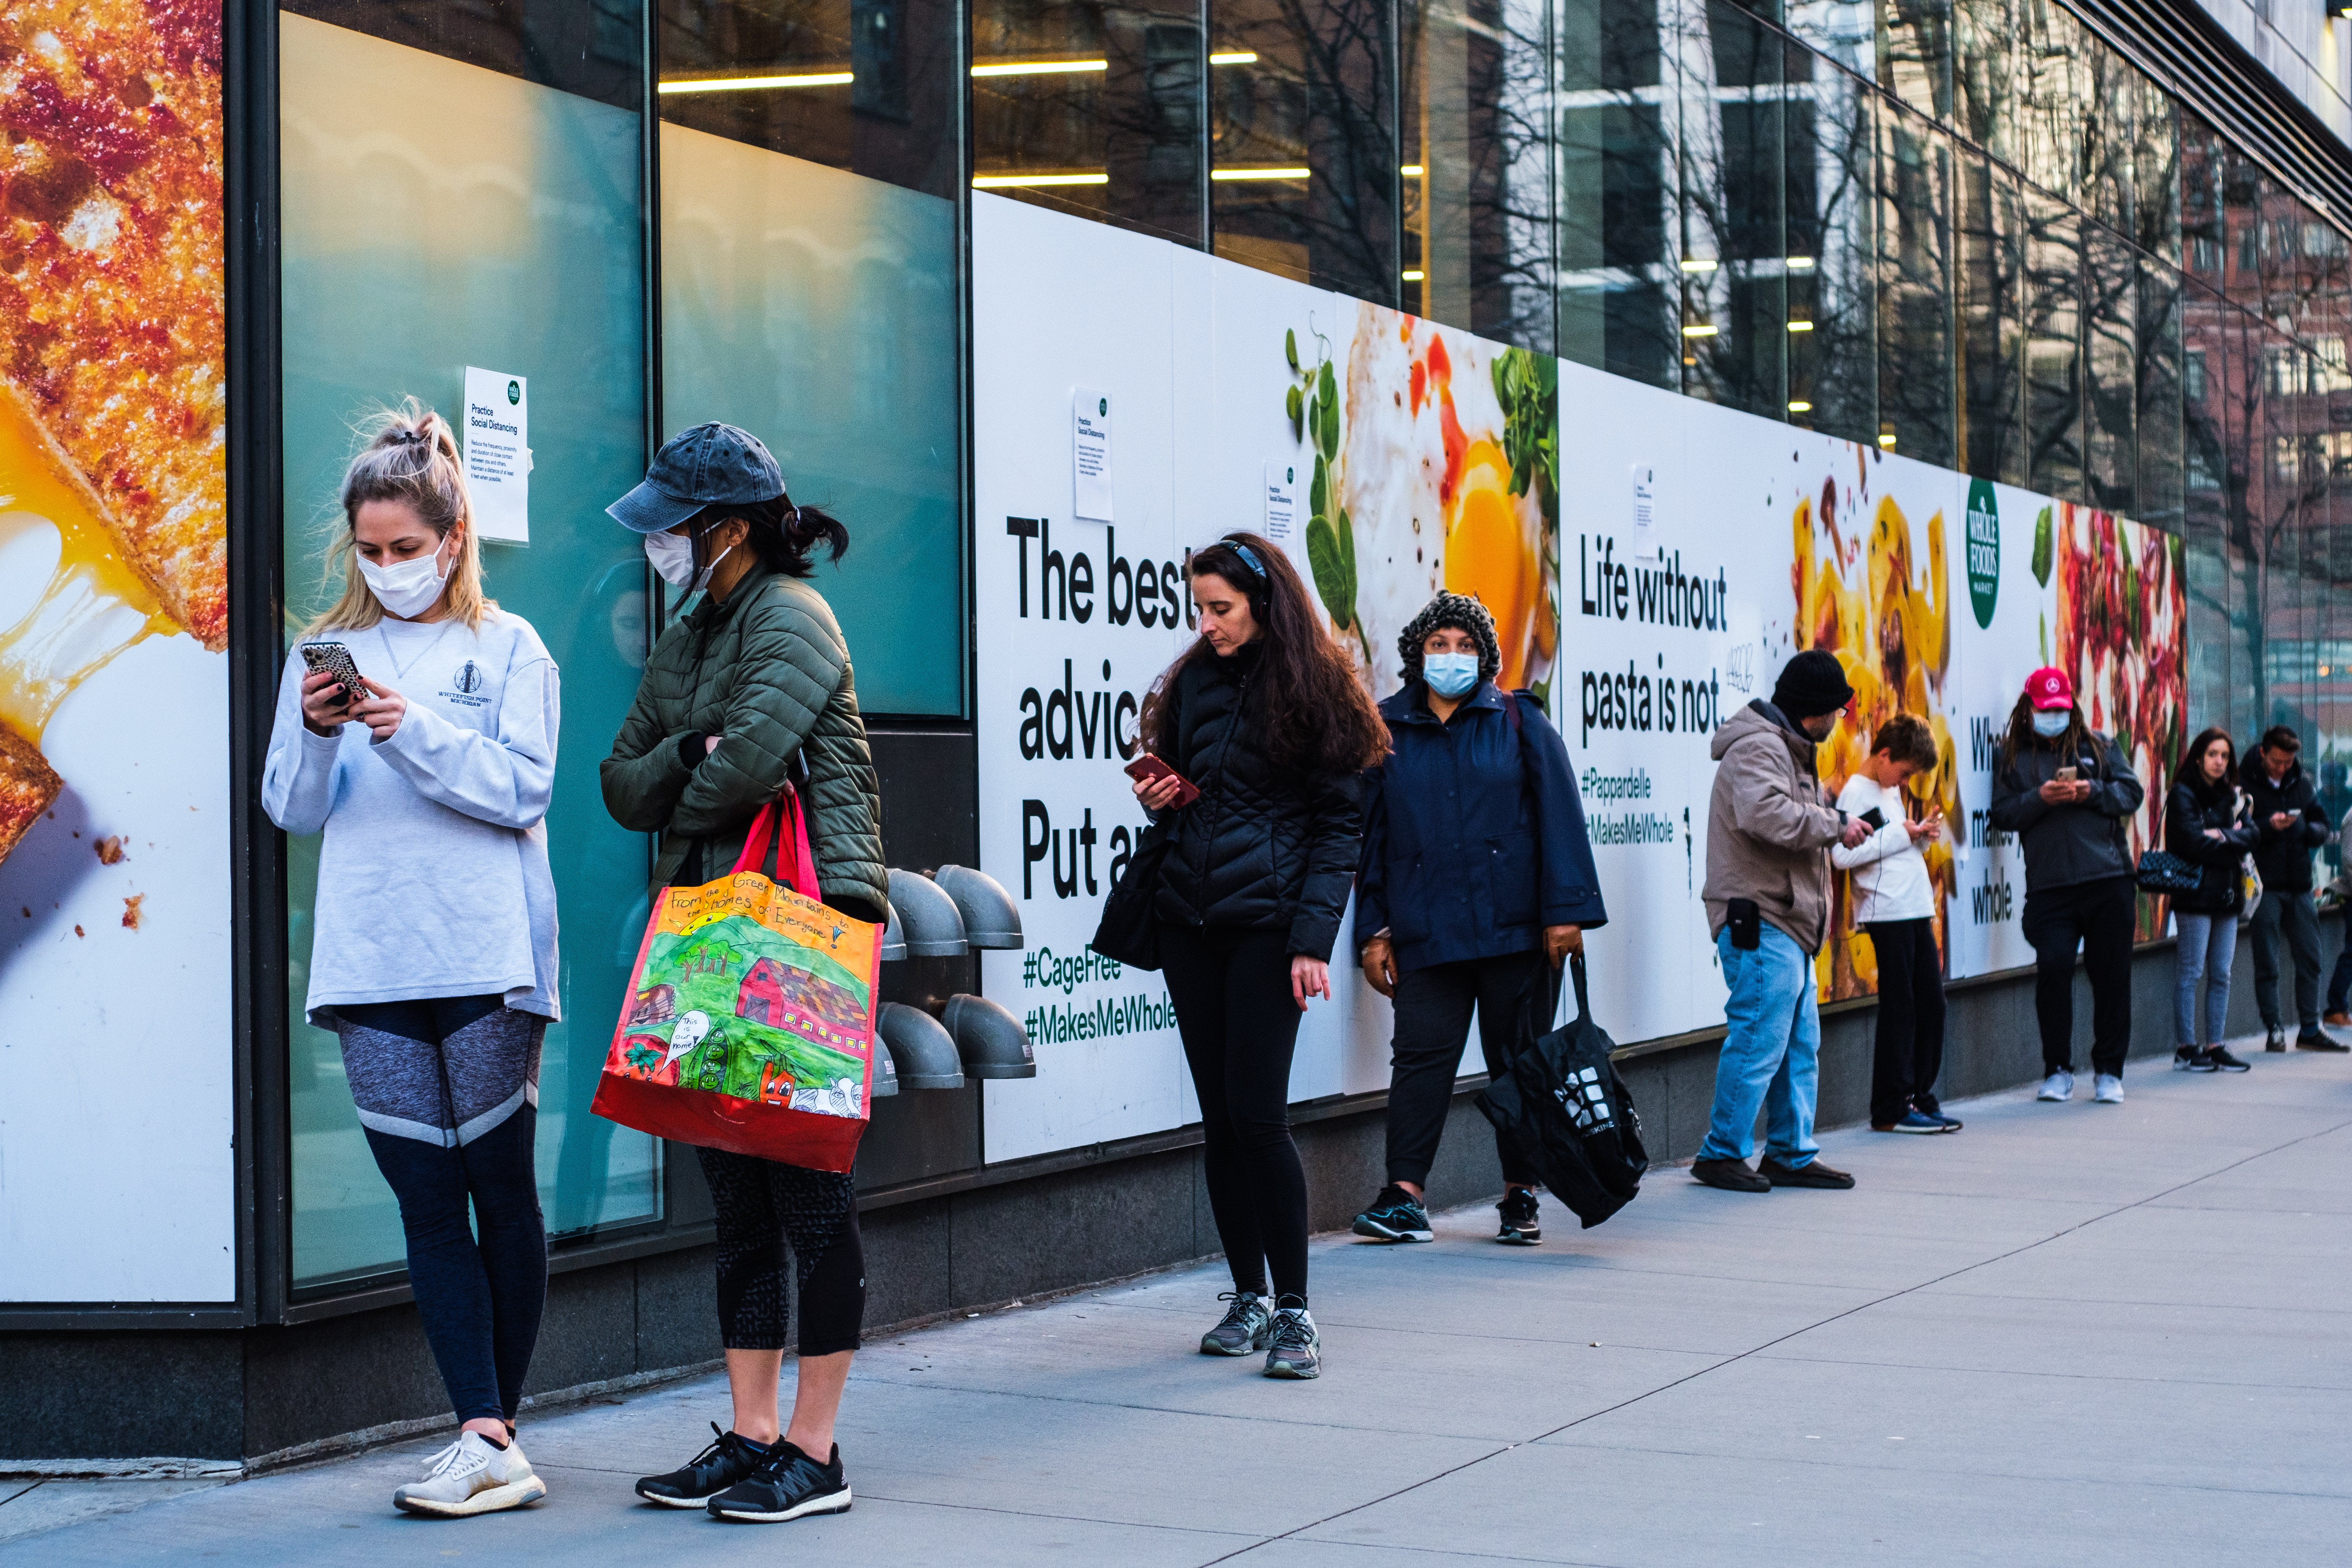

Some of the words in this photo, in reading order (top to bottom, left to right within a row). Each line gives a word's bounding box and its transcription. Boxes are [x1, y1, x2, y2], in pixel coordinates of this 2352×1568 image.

[471, 416, 487, 428] Social
[489, 419, 517, 435] Distancing
[472, 403, 493, 416] Practice
[1969, 510, 1997, 544] WHOLE
[1007, 516, 1094, 624] The
[1107, 526, 1197, 631] best
[1581, 534, 1629, 620] Life
[1635, 547, 1727, 632] without
[1970, 543, 1997, 577] FOODS
[438, 691, 474, 700] WHITEFISH
[450, 698, 481, 707] MICHIGAN
[1582, 660, 1652, 749] pasta
[1658, 652, 1676, 733] is
[1971, 716, 2008, 770] Wh
[1582, 767, 1651, 807] #Pappardelle
[1022, 799, 1098, 900] Put
[1110, 825, 1151, 888] a
[671, 891, 701, 908] From
[706, 889, 719, 897] the
[733, 871, 769, 894] Green
[775, 885, 831, 920] Mountains
[839, 918, 849, 928] to
[688, 910, 700, 918] the
[711, 897, 752, 910] homes
[758, 906, 771, 917] of
[1972, 866, 2012, 925] whole
[1023, 944, 1121, 995] #CageFree
[1025, 992, 1177, 1046] #MakesMeWhole
